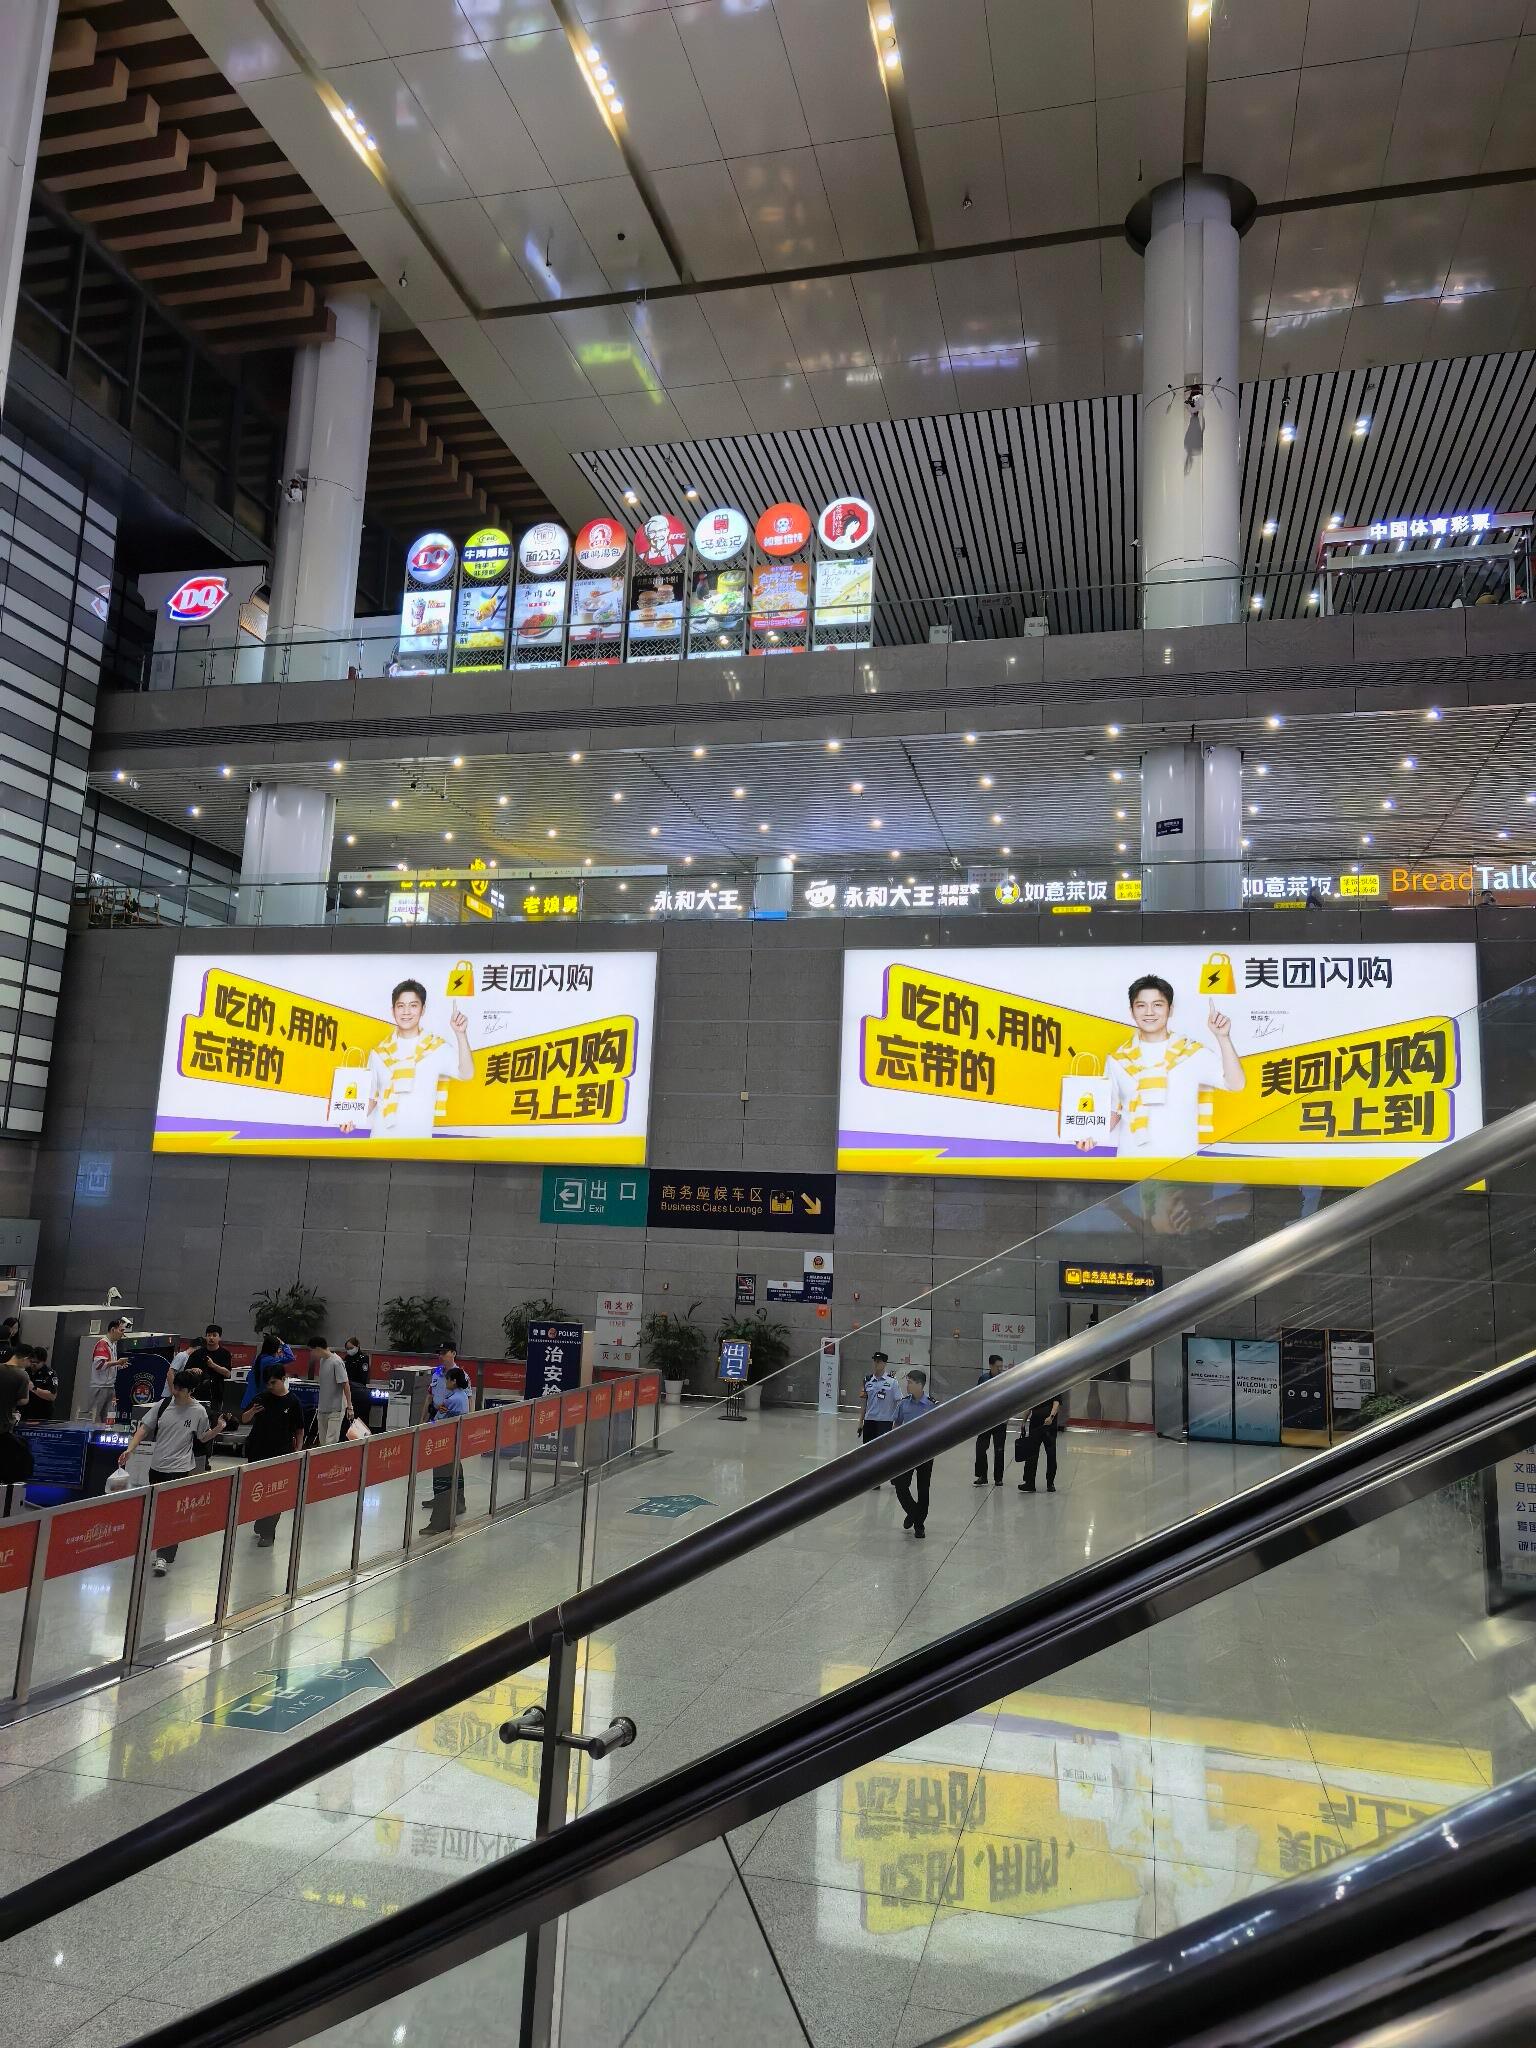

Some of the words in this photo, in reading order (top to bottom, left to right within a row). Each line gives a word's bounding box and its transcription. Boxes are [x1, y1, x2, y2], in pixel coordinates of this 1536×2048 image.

[669, 532, 686, 540] KFC
[1370, 513, 1491, 540] 中国体育彩票
[417, 549, 446, 567] DQ
[180, 584, 219, 610] DQ
[843, 885, 935, 908] 永和大王
[1024, 880, 1108, 902] 如意菜饭
[1242, 876, 1332, 898] 如意菜饭
[523, 895, 578, 914] 老娘舅
[652, 889, 741, 912] 永和大王
[481, 963, 594, 993] 美团闪购
[1244, 957, 1394, 989] 美团闪购
[190, 1030, 284, 1085] 忘带的
[485, 1027, 627, 1087] 美团闪购
[875, 1033, 996, 1096] 忘带的
[1261, 1030, 1448, 1097] 美团闪购
[510, 1082, 613, 1121] 马上到
[1065, 1113, 1107, 1126] 美团闪购
[1299, 1092, 1436, 1139] 马上到
[590, 1179, 637, 1201] 出口
[661, 1185, 763, 1202] 商务座候车区
[588, 1204, 605, 1213] Exit
[660, 1201, 701, 1212] Business
[702, 1203, 728, 1213] Class
[729, 1204, 763, 1215] Lounge
[604, 1299, 634, 1311] 消火栓
[889, 1316, 922, 1328] 消火栓
[991, 1322, 1026, 1334] 消火栓
[558, 1330, 579, 1338] POLICE
[727, 1344, 745, 1369] 出口
[1236, 1381, 1267, 1389] WELCOME
